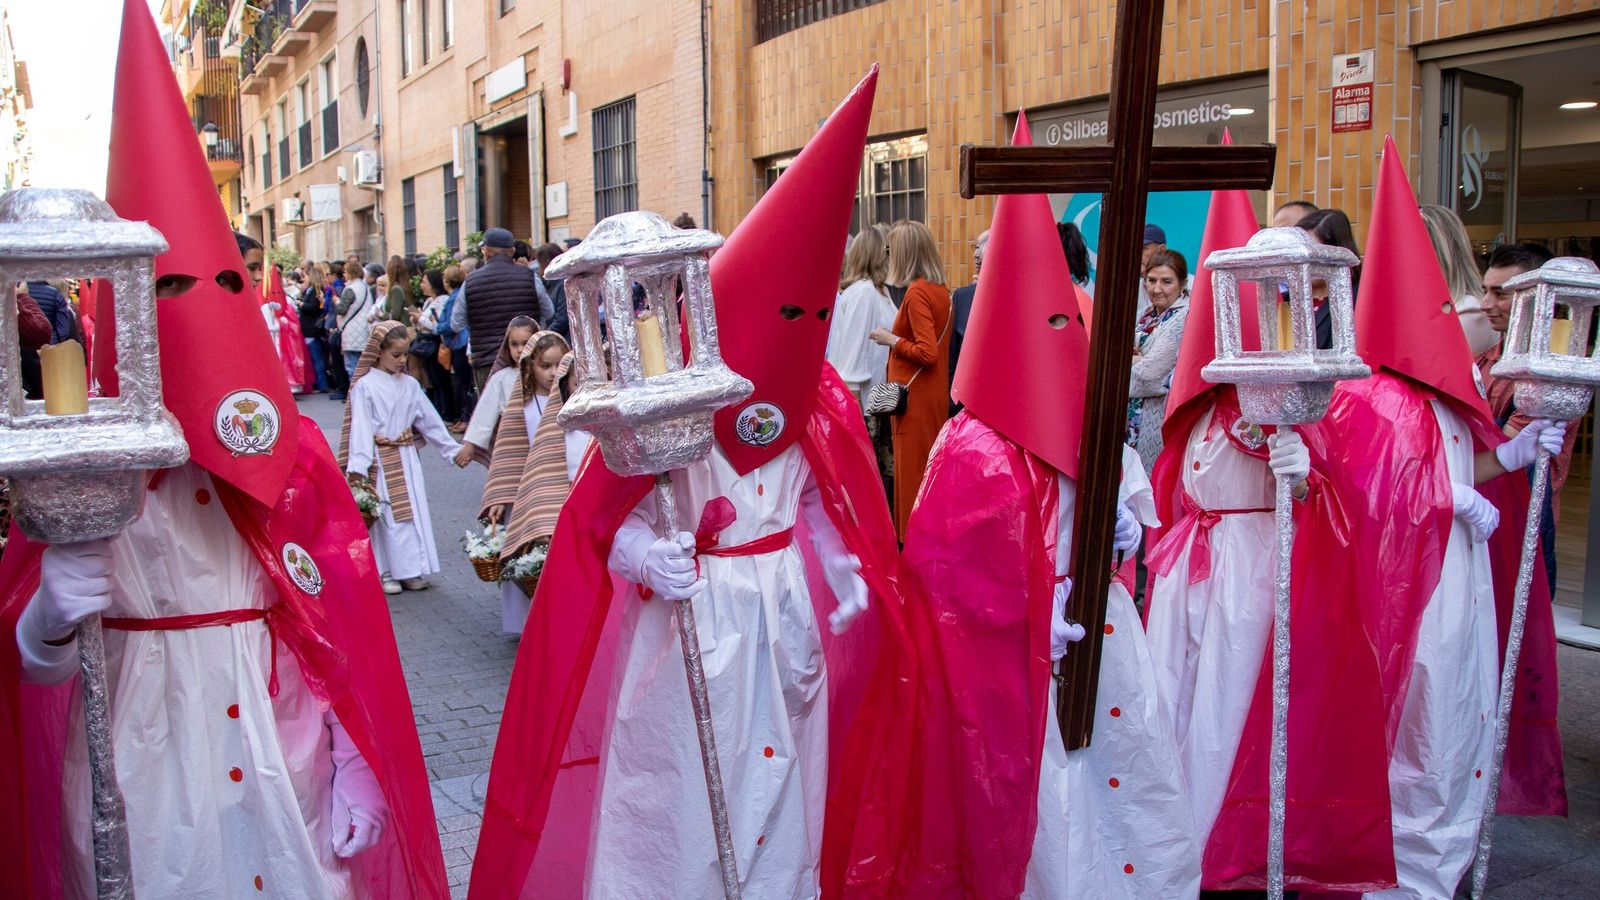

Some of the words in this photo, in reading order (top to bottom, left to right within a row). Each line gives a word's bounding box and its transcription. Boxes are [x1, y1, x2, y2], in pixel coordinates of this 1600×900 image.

[1335, 87, 1370, 99] Alarma
[1062, 119, 1108, 141] Silbea
[1153, 101, 1232, 128] osmetics
